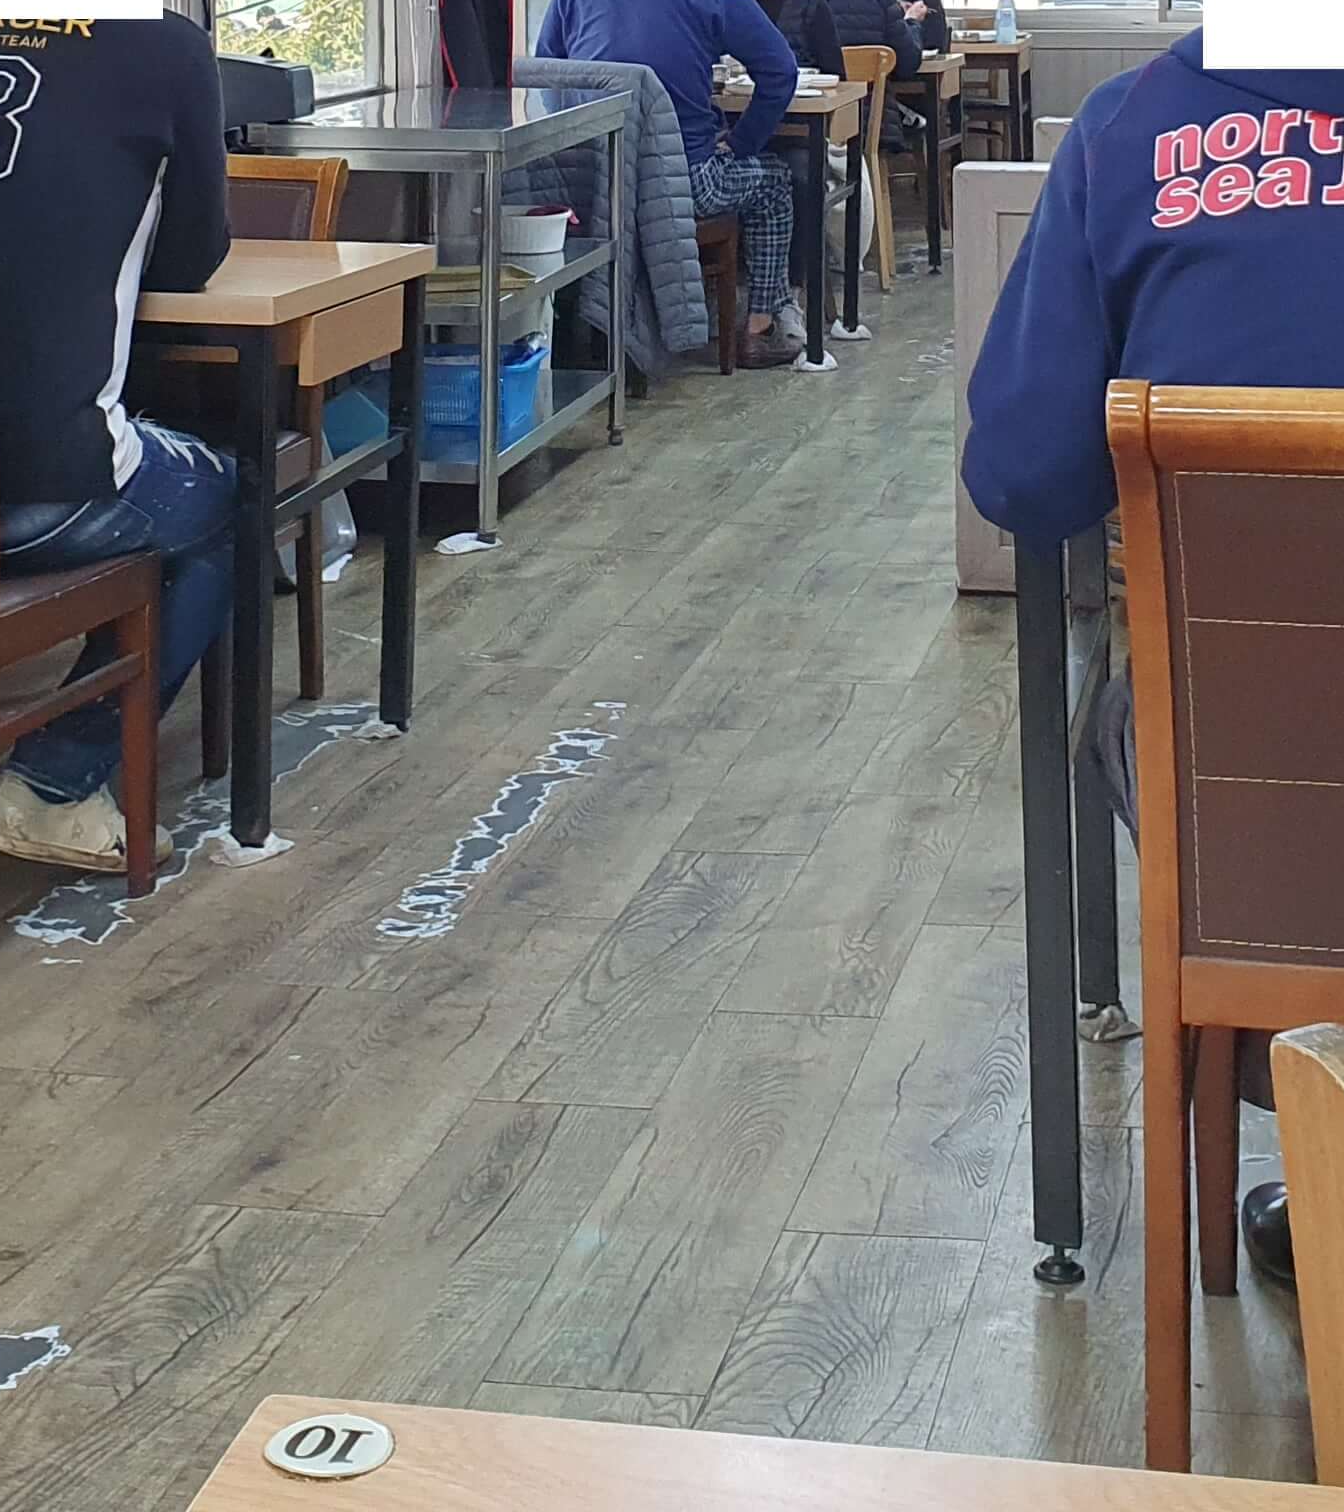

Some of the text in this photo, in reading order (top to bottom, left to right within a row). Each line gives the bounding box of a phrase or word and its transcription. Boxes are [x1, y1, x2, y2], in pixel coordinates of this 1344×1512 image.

[0, 34, 48, 49] TEAM
[1151, 157, 1311, 228] sea
[284, 1424, 374, 1464] 10
